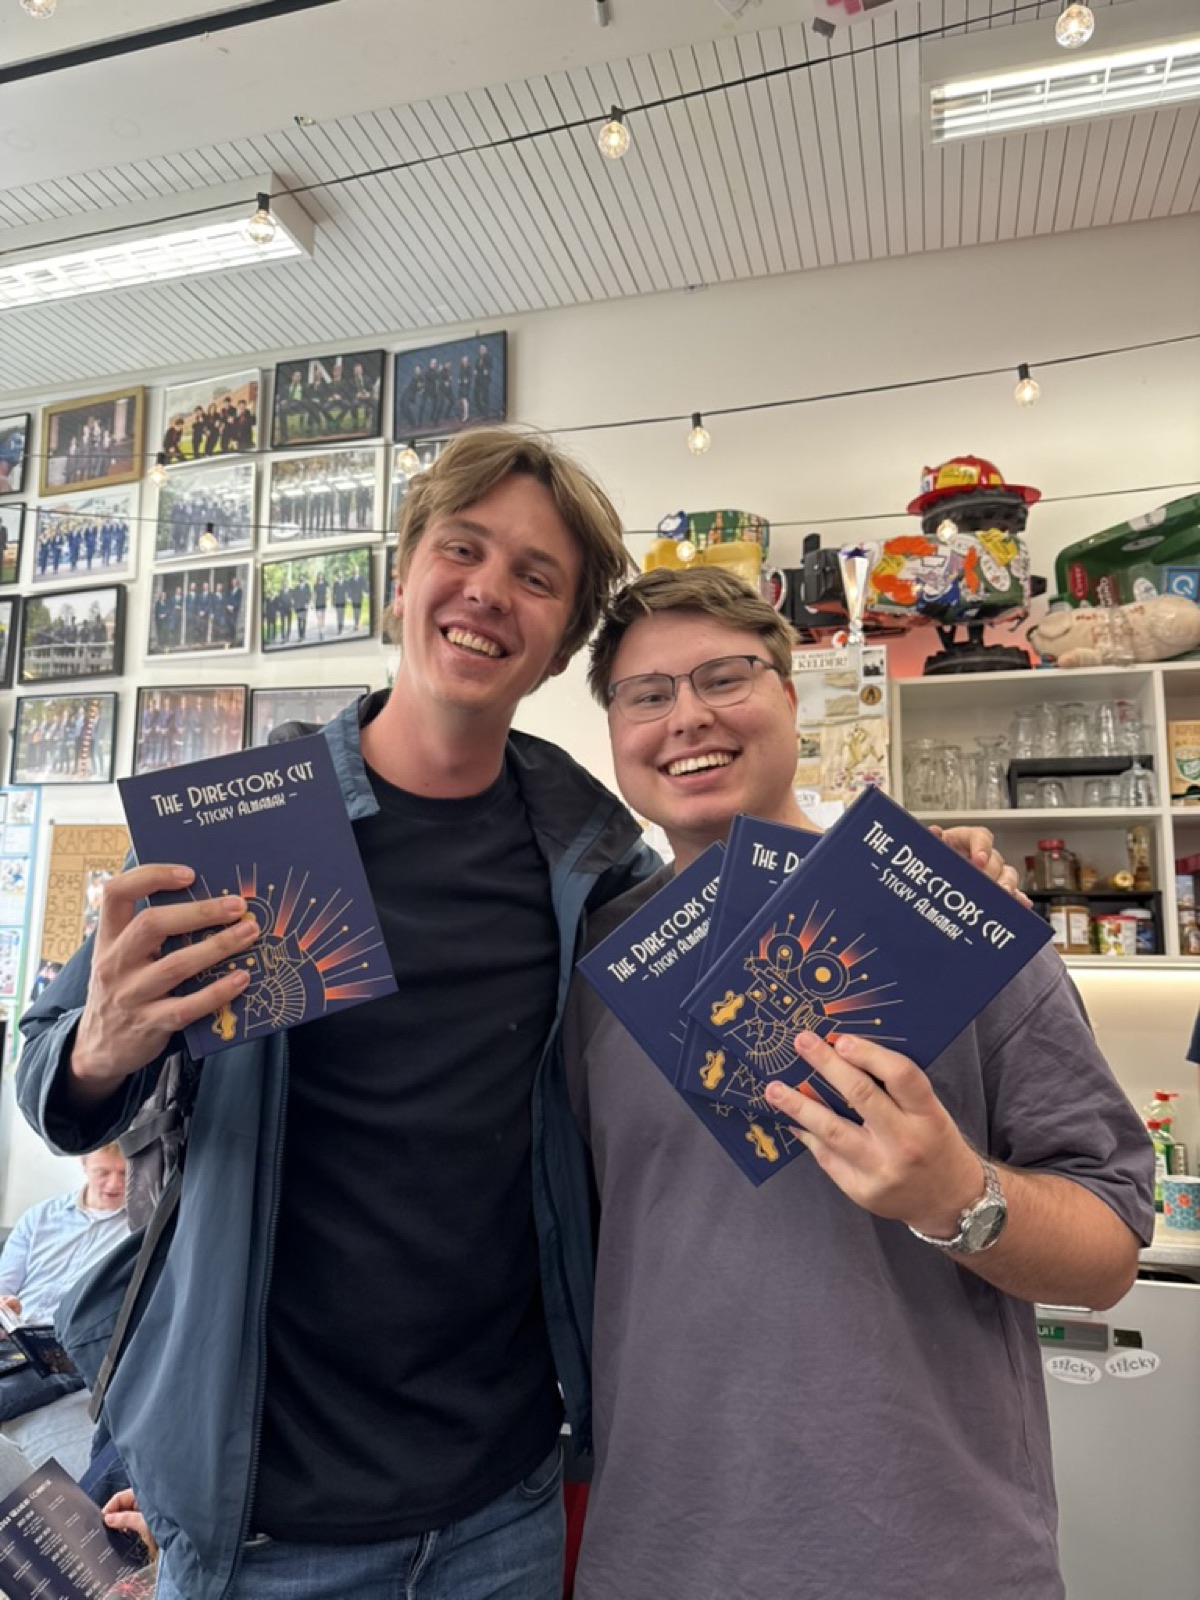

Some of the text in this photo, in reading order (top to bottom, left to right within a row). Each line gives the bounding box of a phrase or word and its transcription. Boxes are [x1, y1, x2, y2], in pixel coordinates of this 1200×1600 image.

[151, 761, 314, 816] THE DIRECTORS CUT
[196, 793, 286, 826] STICKY ALMANAK
[752, 842, 778, 871] THE
[863, 820, 895, 855] THE
[891, 844, 984, 926] DIRECTORS
[982, 919, 1016, 950] CUT
[878, 868, 963, 940] STICKY ALMANAK
[607, 957, 637, 983] THE
[630, 897, 706, 964] DIRECTORS
[649, 948, 679, 978] STICKY
